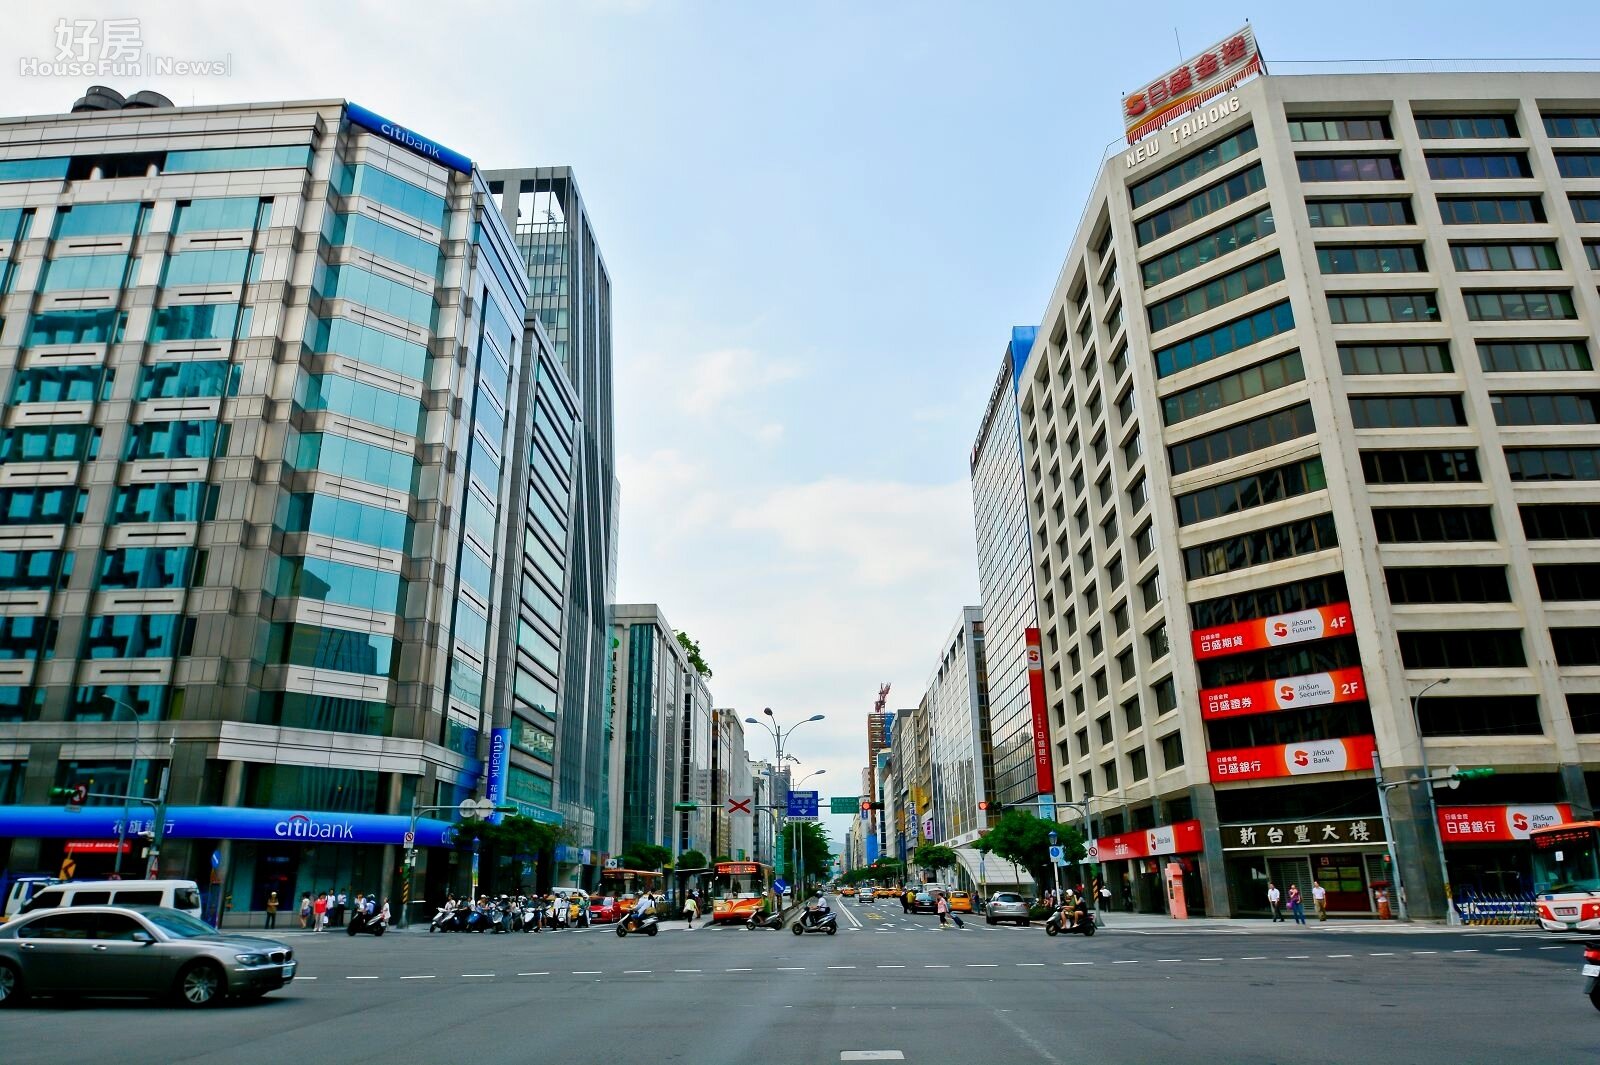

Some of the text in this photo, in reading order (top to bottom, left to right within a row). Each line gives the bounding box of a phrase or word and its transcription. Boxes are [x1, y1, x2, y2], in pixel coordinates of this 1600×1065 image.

[1148, 35, 1247, 107] 日盛金控
[1126, 96, 1240, 168] NEW TAIHONG
[381, 123, 440, 159] citibank
[1291, 616, 1347, 629] JihSun 4F
[1292, 625, 1316, 634] Futures
[1201, 635, 1243, 652] 日盛期貨
[1298, 682, 1358, 695] JihSun 2F
[1299, 689, 1331, 698] Securities
[1209, 697, 1252, 712] 日盛證券
[491, 734, 502, 778] citibank
[1313, 749, 1335, 757] JihSun
[1313, 756, 1331, 764] Bank
[1218, 760, 1261, 775] 日盛銀行
[488, 784, 498, 820] 花旗行
[1532, 814, 1554, 822] JihSun
[275, 818, 353, 839] citibank
[1240, 820, 1370, 845] 新台豐大樓
[1447, 820, 1496, 834] 日盛銀行
